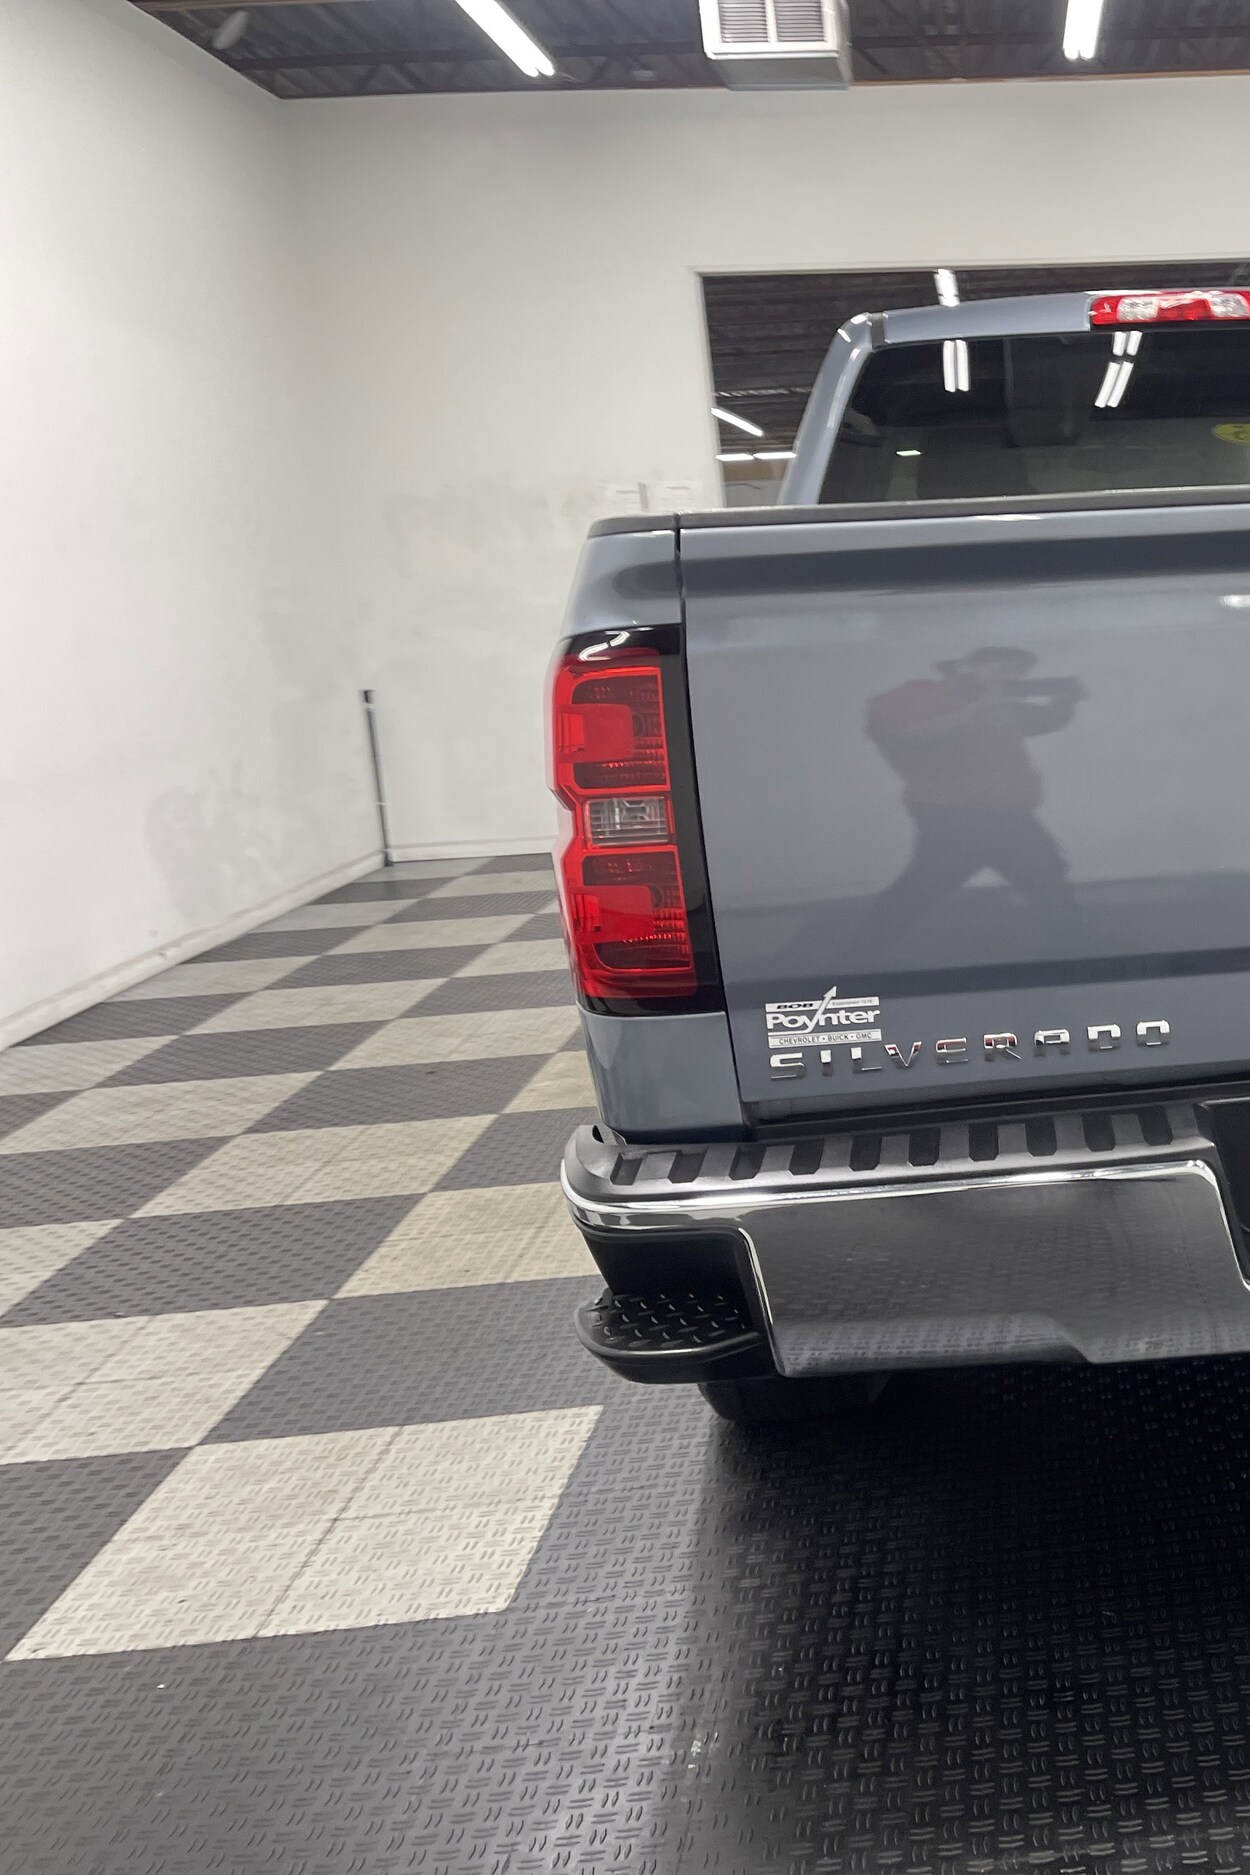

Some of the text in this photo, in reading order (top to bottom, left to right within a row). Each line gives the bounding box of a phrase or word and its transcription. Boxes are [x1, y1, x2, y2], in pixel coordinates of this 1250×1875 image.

[766, 1010, 880, 1033] Poynter
[770, 1020, 1170, 1080] SILVERADO
[779, 1032, 872, 1045] CHEVROLET BUICK GMC
